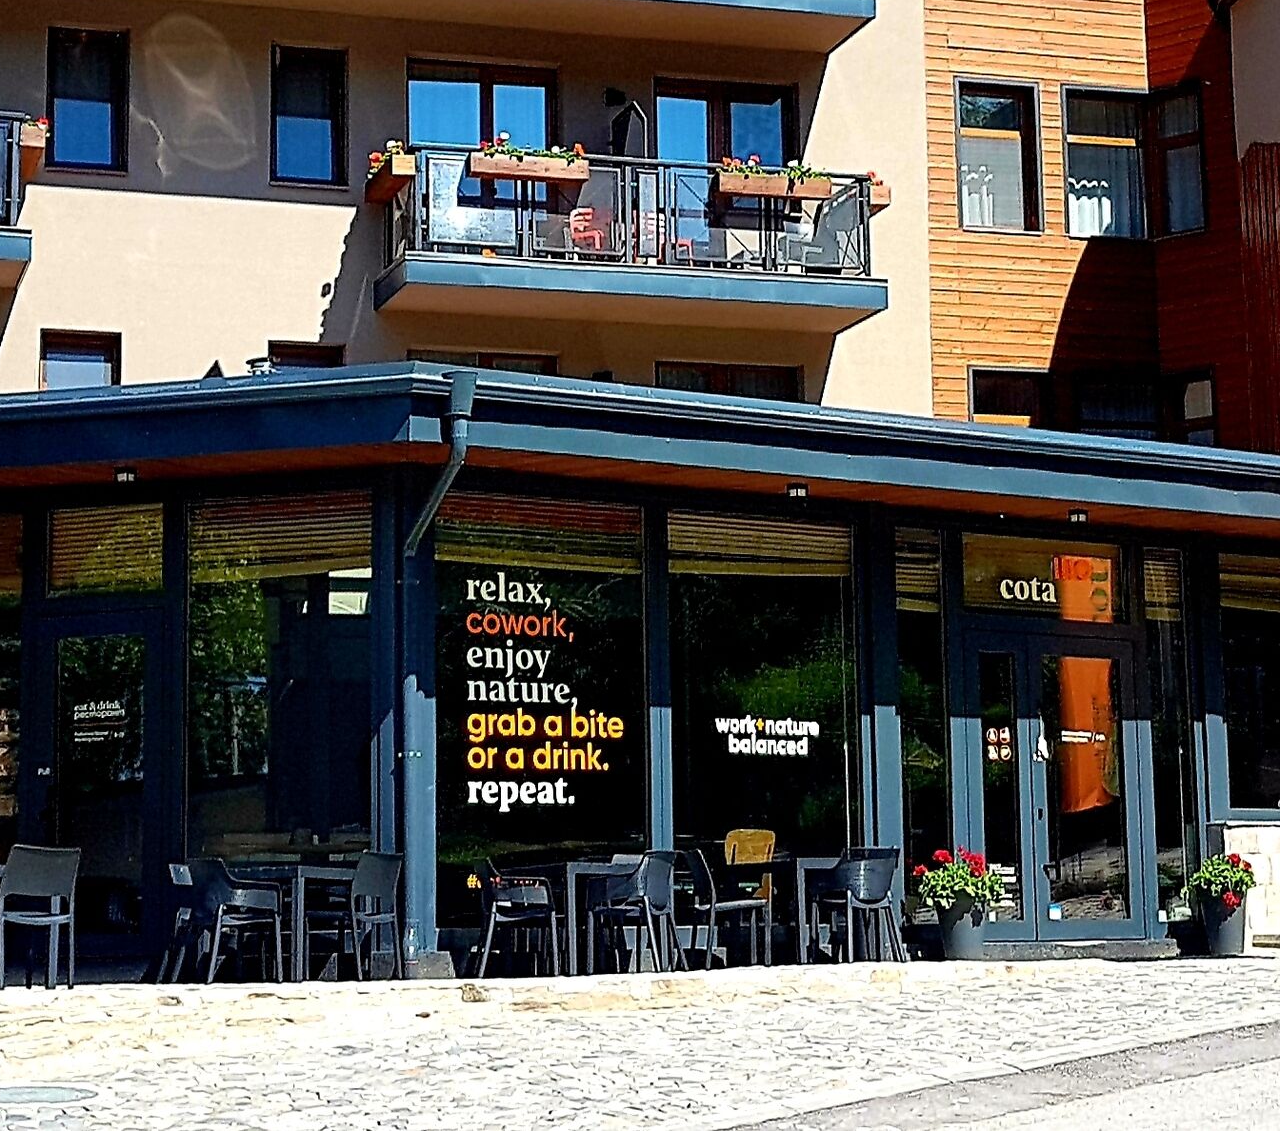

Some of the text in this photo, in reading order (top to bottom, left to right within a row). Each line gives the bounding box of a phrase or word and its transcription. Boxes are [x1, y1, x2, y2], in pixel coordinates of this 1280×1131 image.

[466, 572, 552, 612] relax,
[1000, 577, 1057, 603] cota
[466, 609, 574, 643] cowork,
[466, 639, 552, 678] enjoy
[467, 676, 578, 710] nature,
[467, 707, 624, 743] grab a bite
[467, 740, 610, 771] or a drink.
[728, 733, 809, 756] balanced
[467, 777, 576, 813] repeat.
